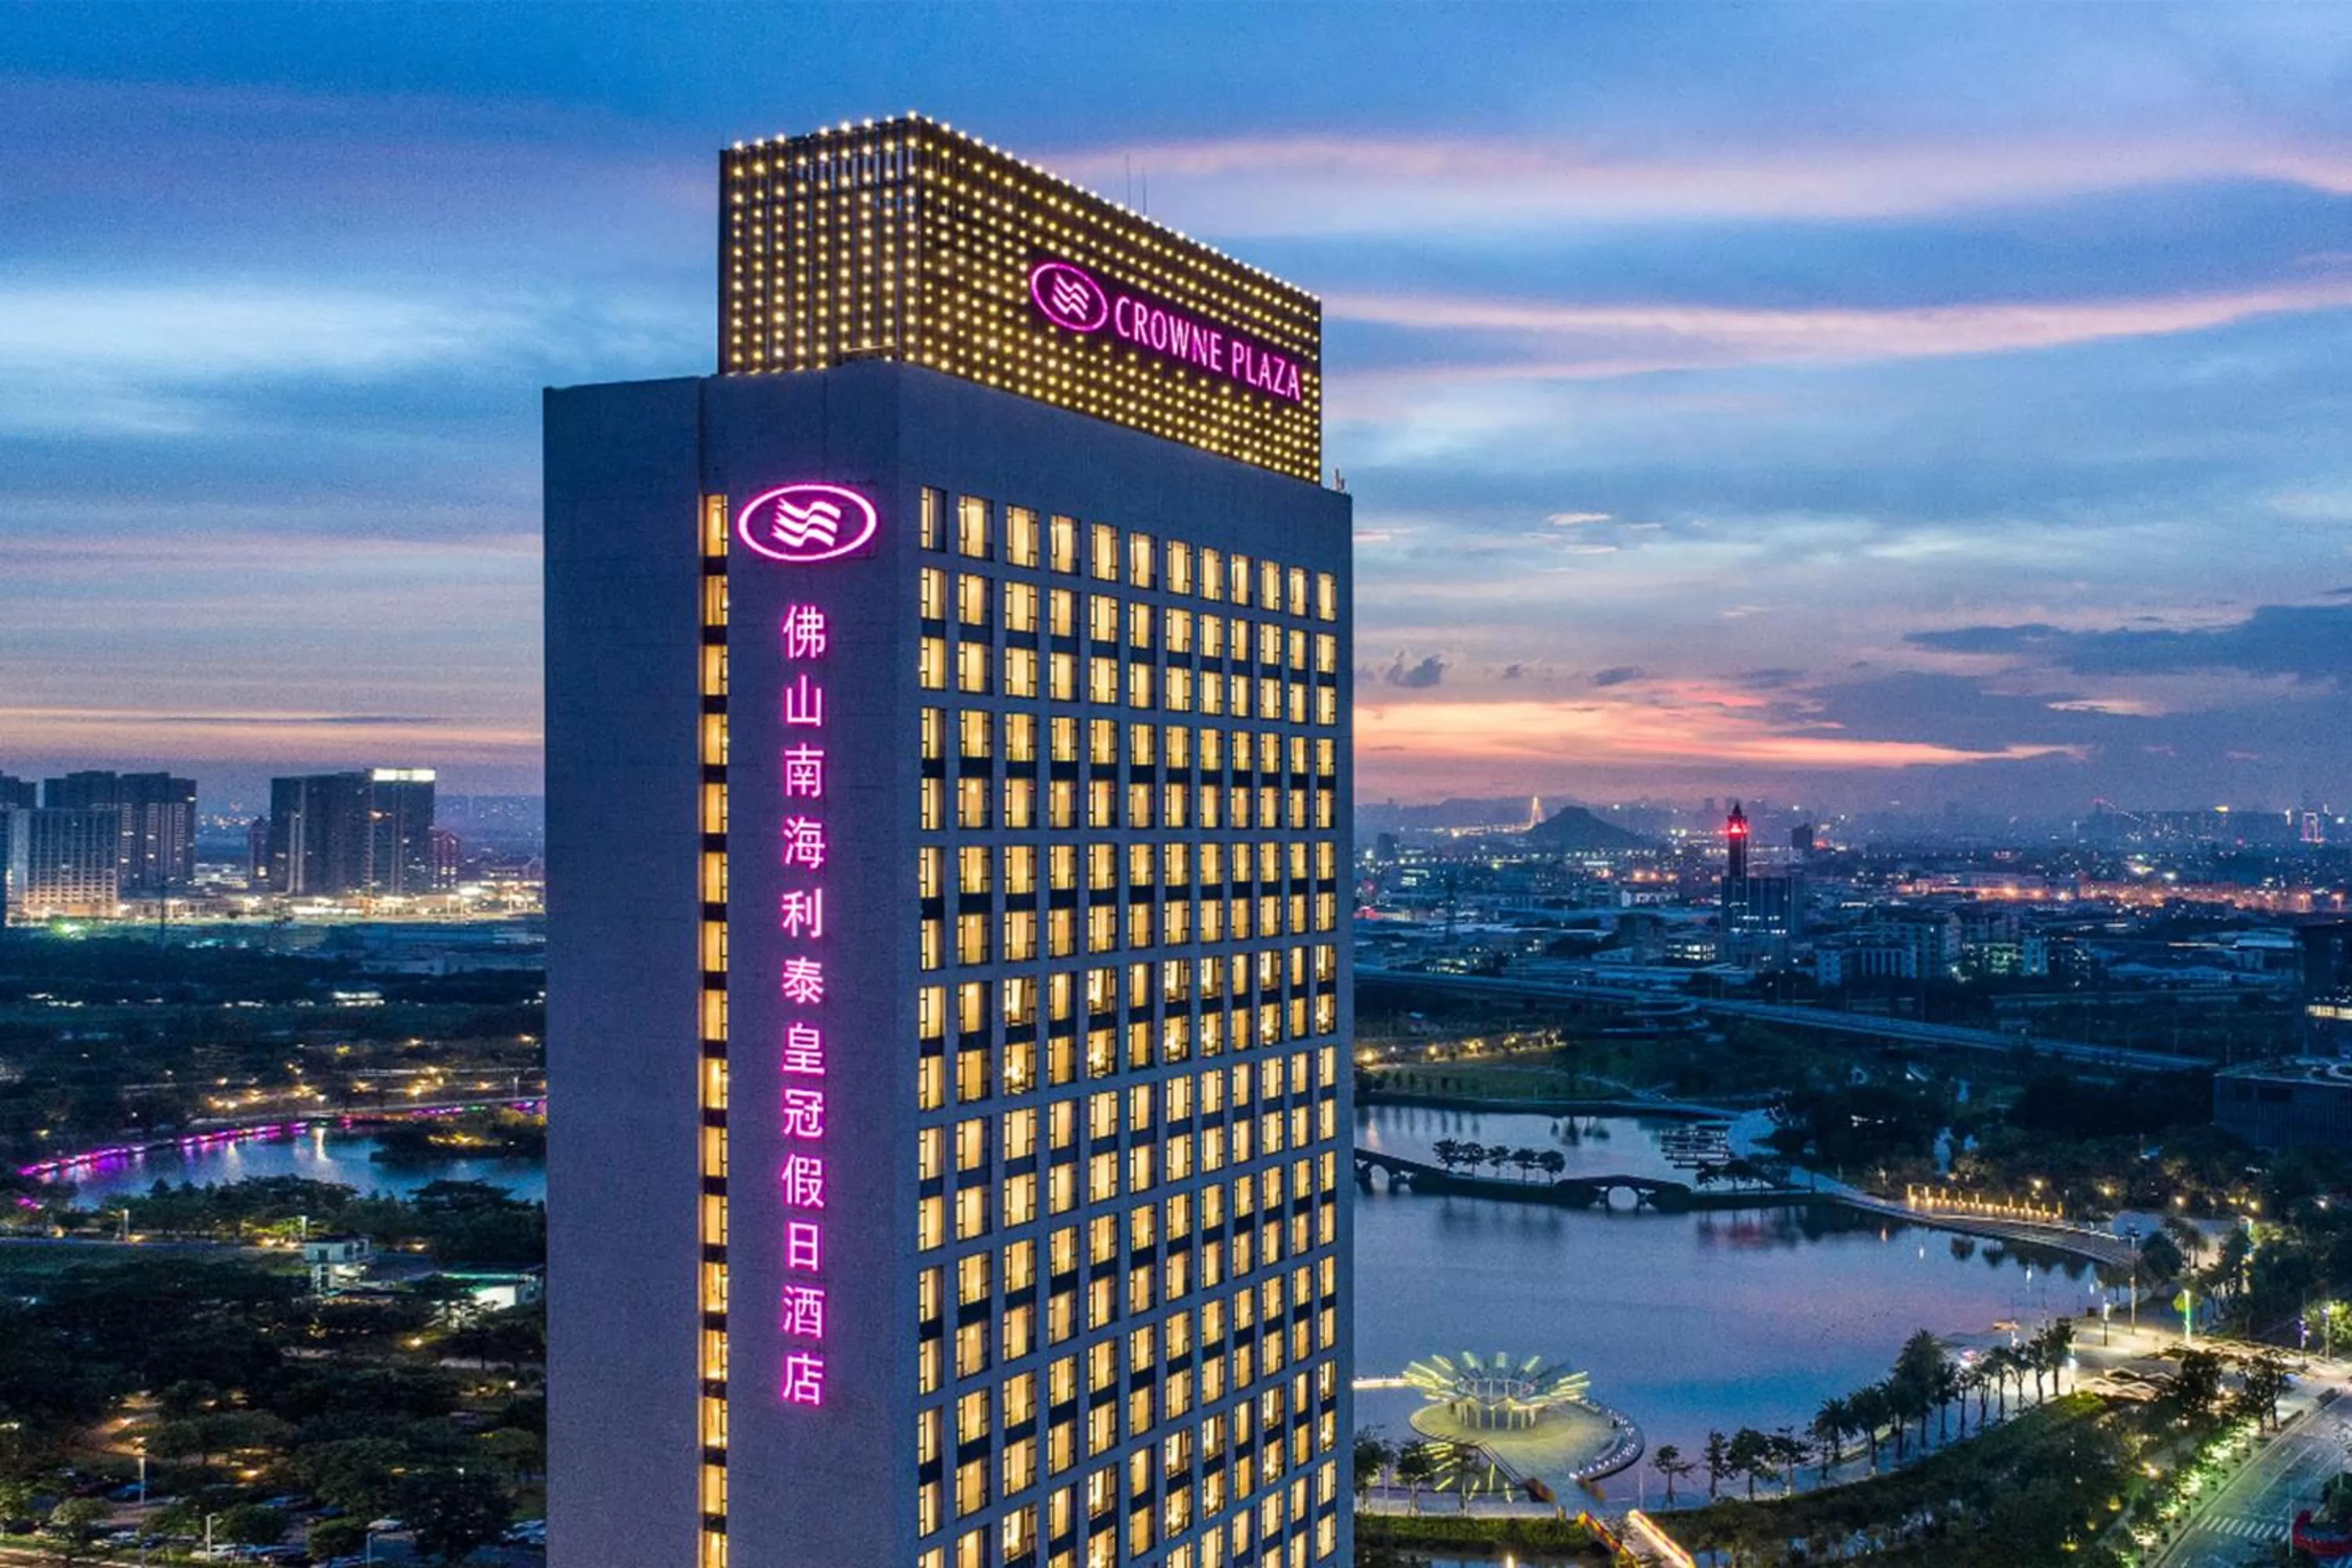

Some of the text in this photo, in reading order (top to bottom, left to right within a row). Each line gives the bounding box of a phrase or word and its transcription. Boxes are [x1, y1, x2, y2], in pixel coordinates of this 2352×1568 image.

[1114, 296, 1301, 401] CROWNE PLAZA
[782, 604, 825, 1406] 佛山南海利泰皇冠假日酒店
